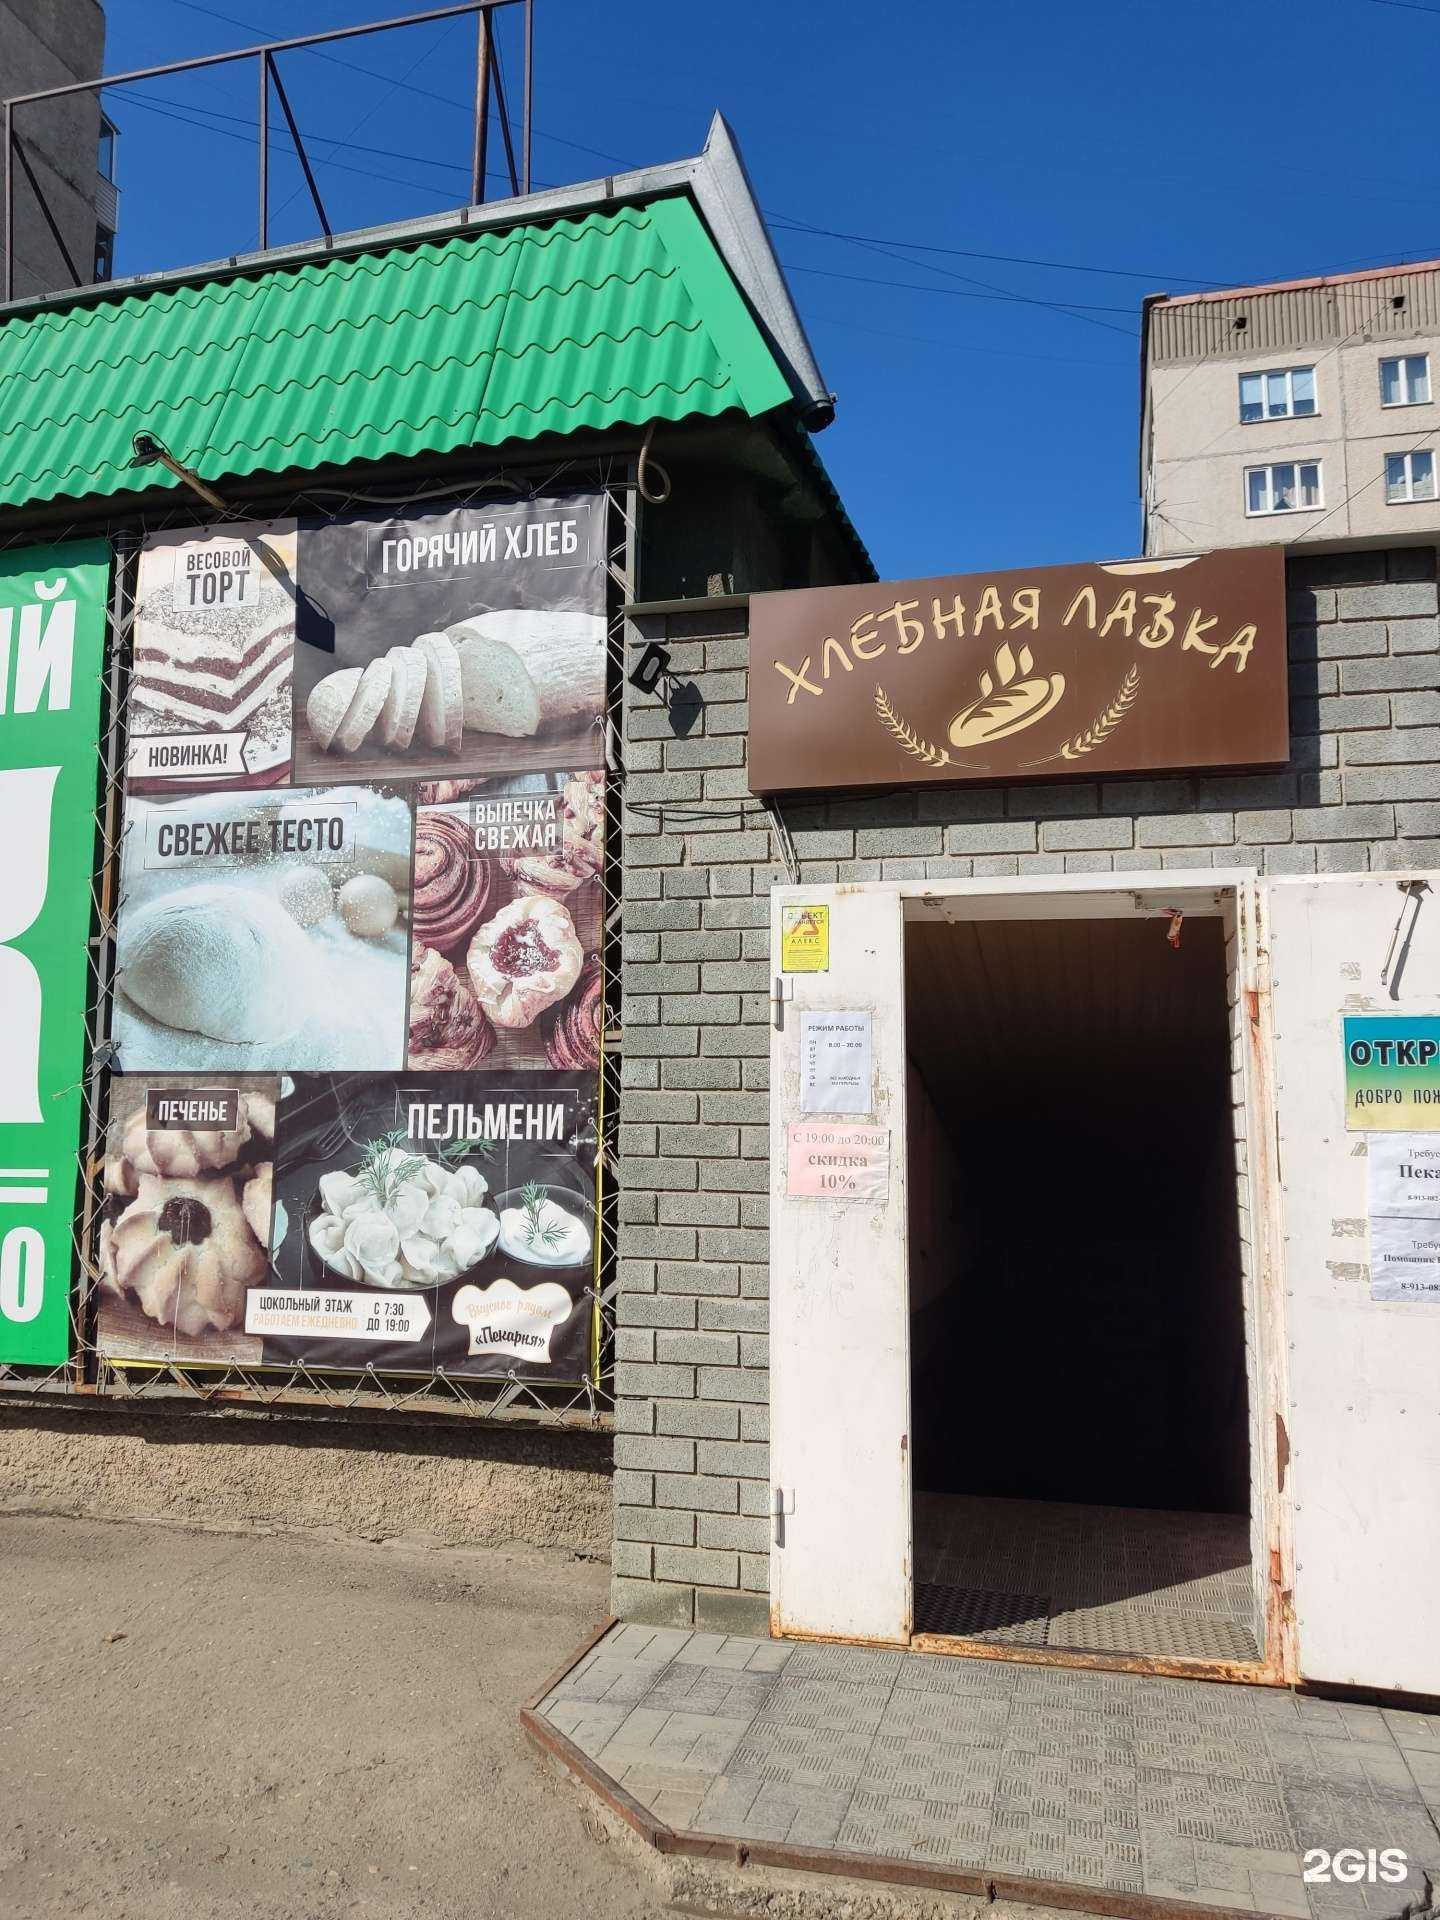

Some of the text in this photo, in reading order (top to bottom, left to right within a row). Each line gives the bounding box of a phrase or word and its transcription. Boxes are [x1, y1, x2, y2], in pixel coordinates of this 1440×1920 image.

[186, 546, 251, 571] ВЕСОВОЙ
[382, 519, 578, 574] ГОРЯЧИЙ ХЛЕБ
[186, 570, 250, 605] ТОРТ
[773, 585, 1258, 705] ХЛЕБНАЯ ЛАВКА
[148, 743, 228, 767] НОВИНКА!
[474, 799, 556, 824] ВЫПЕЧКА
[158, 817, 344, 857] СВЕЖЕЕ ТЕСТО
[474, 824, 556, 851] СВЕЖАЯ
[1349, 1040, 1440, 1067] ОТКР
[159, 1100, 228, 1122] ПЕЧЕНЬЕ
[1355, 1089, 1402, 1109] ДОБРО
[408, 1103, 564, 1142] ПЕЛЬМЕНИ
[793, 1132, 801, 1142] С
[806, 1133, 834, 1143] 19:00
[855, 1134, 885, 1146] 20:00
[808, 1154, 868, 1168] скидка
[820, 1174, 856, 1189] 10%
[259, 1296, 352, 1313] ЦОКОЛЬНЫЙ ЭТАЖ
[374, 1302, 404, 1316] С 7:30
[366, 1318, 410, 1333] ДО 19:00
[475, 1326, 545, 1348] «Пекарня»
